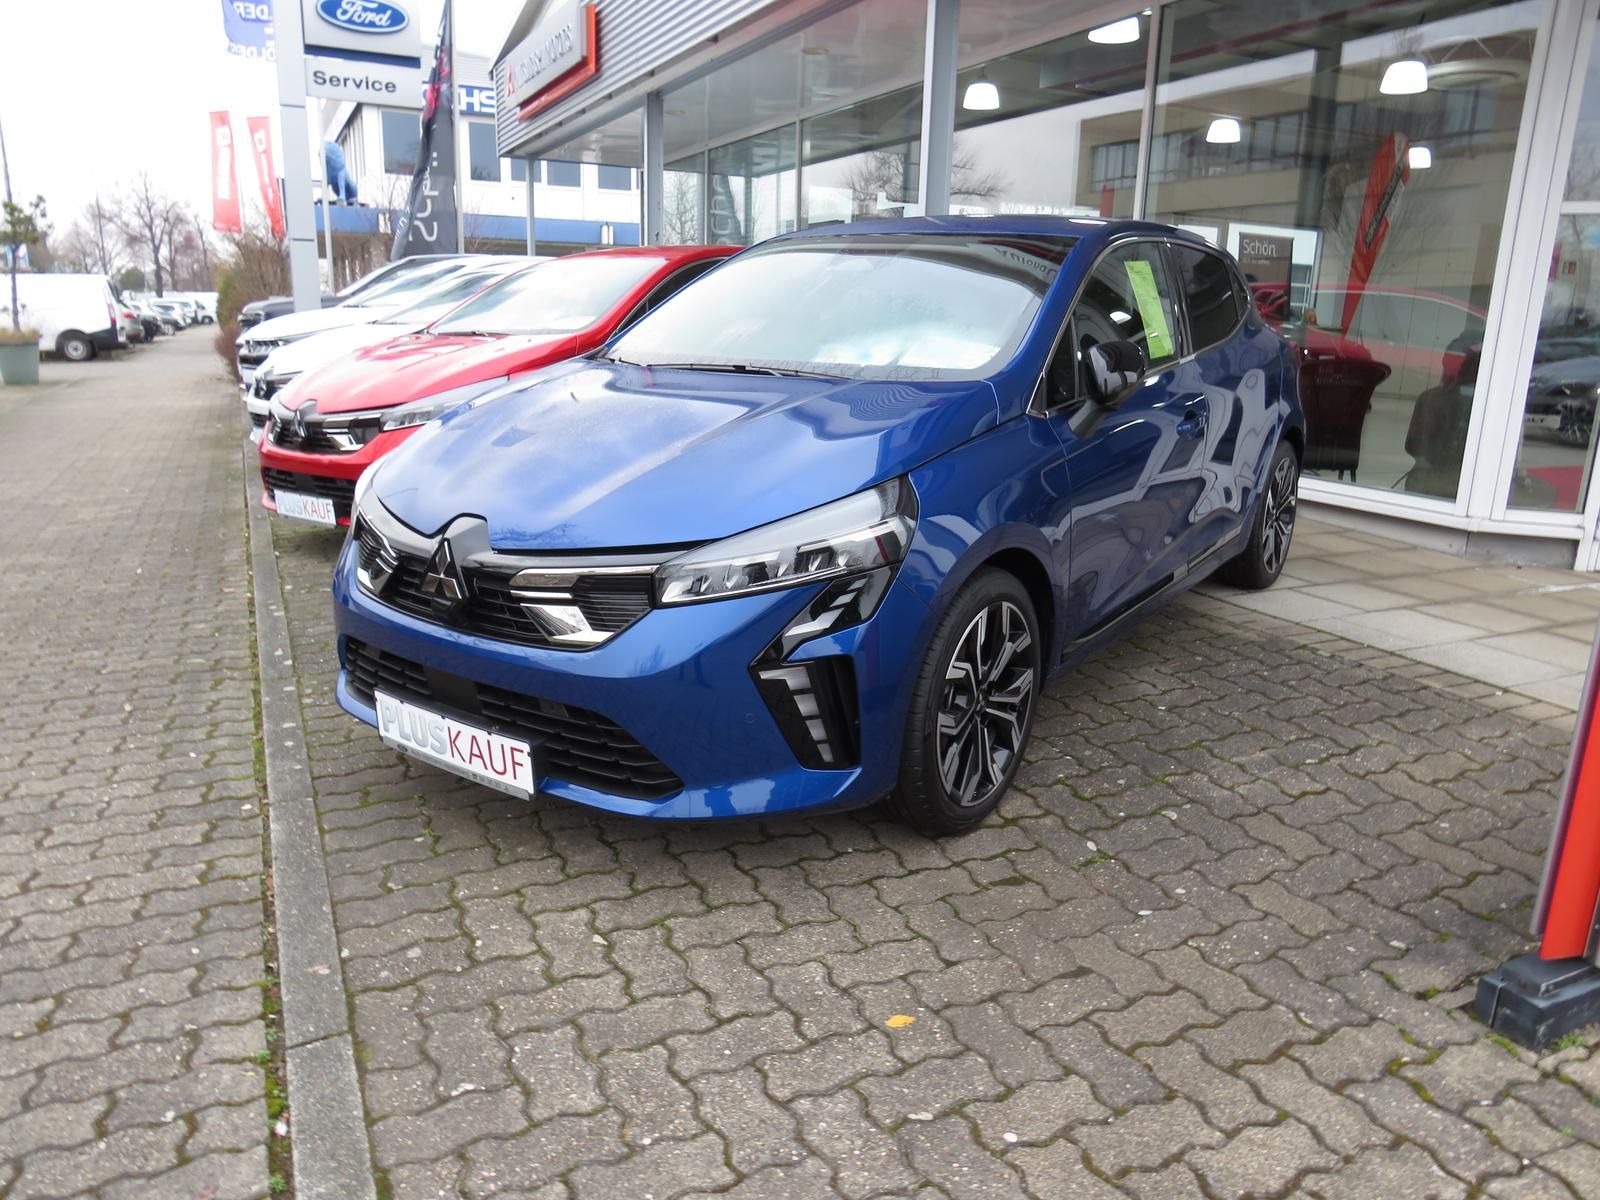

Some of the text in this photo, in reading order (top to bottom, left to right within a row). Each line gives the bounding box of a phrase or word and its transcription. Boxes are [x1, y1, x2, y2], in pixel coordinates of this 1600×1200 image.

[336, 0, 392, 26] Ford
[313, 70, 397, 93] Service
[1243, 239, 1276, 257] Schön
[379, 697, 525, 781] PLUSKAUF
